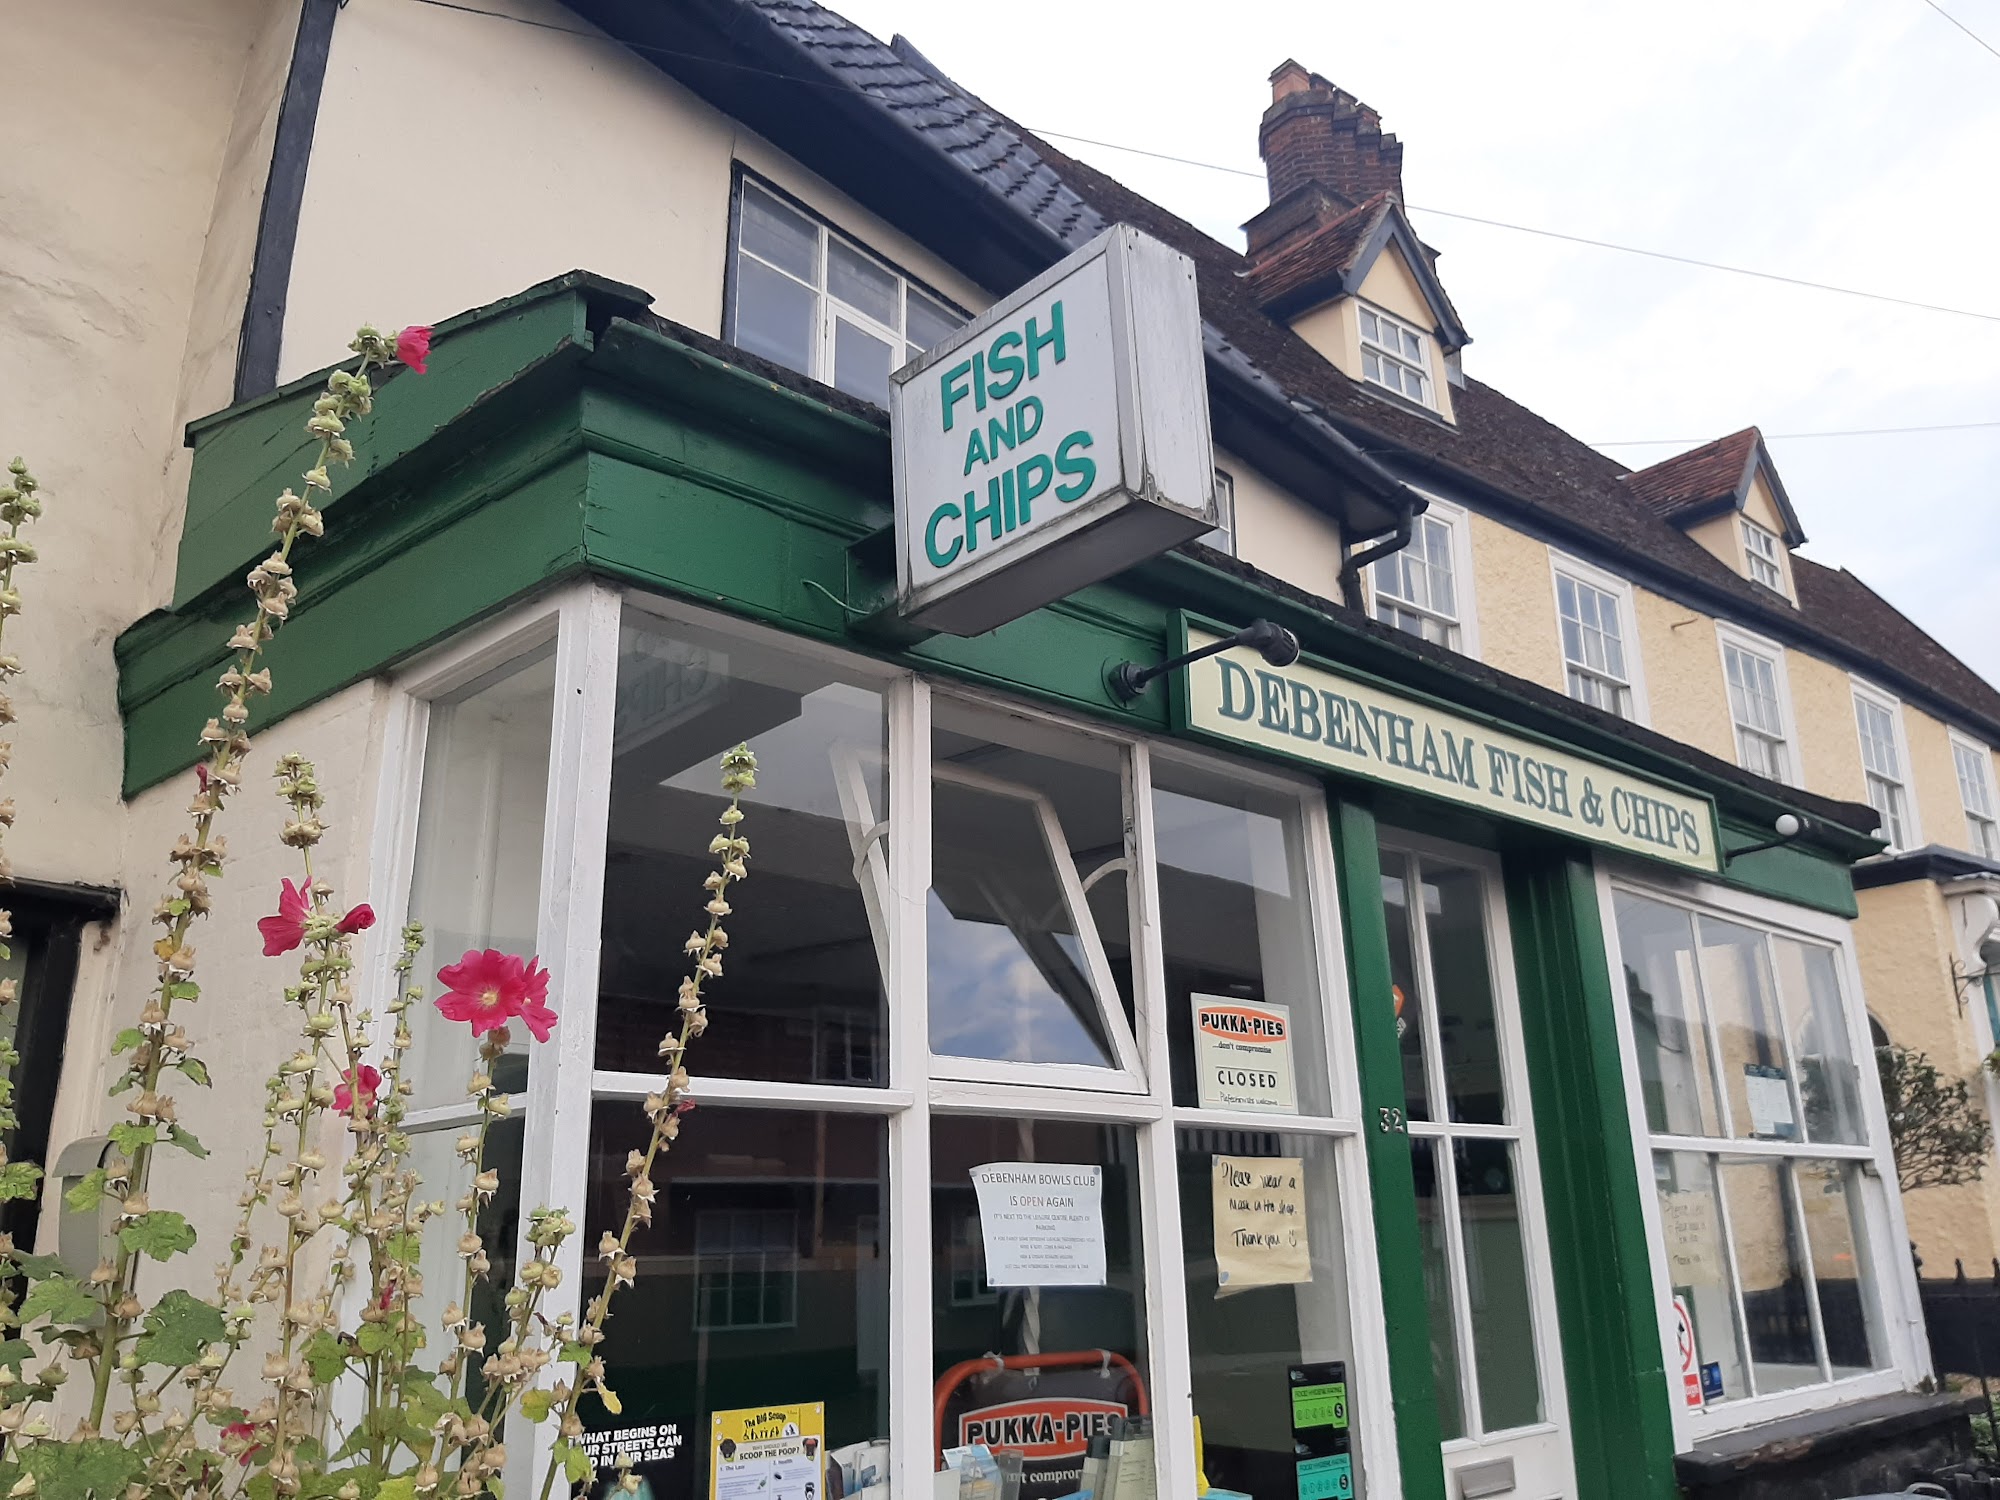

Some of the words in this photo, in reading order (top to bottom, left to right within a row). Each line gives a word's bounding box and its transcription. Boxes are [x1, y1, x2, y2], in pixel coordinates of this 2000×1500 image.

[941, 300, 1066, 432] FISH
[963, 396, 1043, 476] AND
[924, 430, 1097, 569] CHIPS
[1214, 656, 1478, 790] DEBENHAM
[1483, 743, 1573, 818] FISH
[1580, 776, 1604, 827] &
[1611, 786, 1700, 856] CHIPS
[1201, 1013, 1283, 1035] PUKKA-PIES
[1218, 1070, 1276, 1088] CLOSED
[1380, 1106, 1404, 1132] 32
[981, 1173, 1037, 1184] DEBENHAM
[1039, 1174, 1070, 1185] BOWLS
[1073, 1175, 1095, 1186] CLUB
[1221, 1161, 1251, 1187] Please
[1259, 1174, 1282, 1188] wear
[1289, 1177, 1296, 1189] a
[1010, 1196, 1018, 1206] IS
[1020, 1196, 1044, 1206] OPEN
[1046, 1197, 1074, 1207] AGAIN
[1254, 1200, 1261, 1211] in
[1232, 1228, 1263, 1247] Thank
[1264, 1234, 1280, 1250] you
[613, 1425, 657, 1440] BEGINS
[659, 1424, 677, 1436] ON
[744, 1418, 756, 1428] The
[583, 1444, 600, 1456] UR
[602, 1438, 655, 1454] STREETS
[657, 1434, 682, 1447] CAN
[739, 1450, 763, 1460] SCOOP
[765, 1449, 777, 1458] THE
[778, 1447, 800, 1456] POOP?
[601, 1454, 614, 1467] IN
[644, 1447, 675, 1461] SEAS
